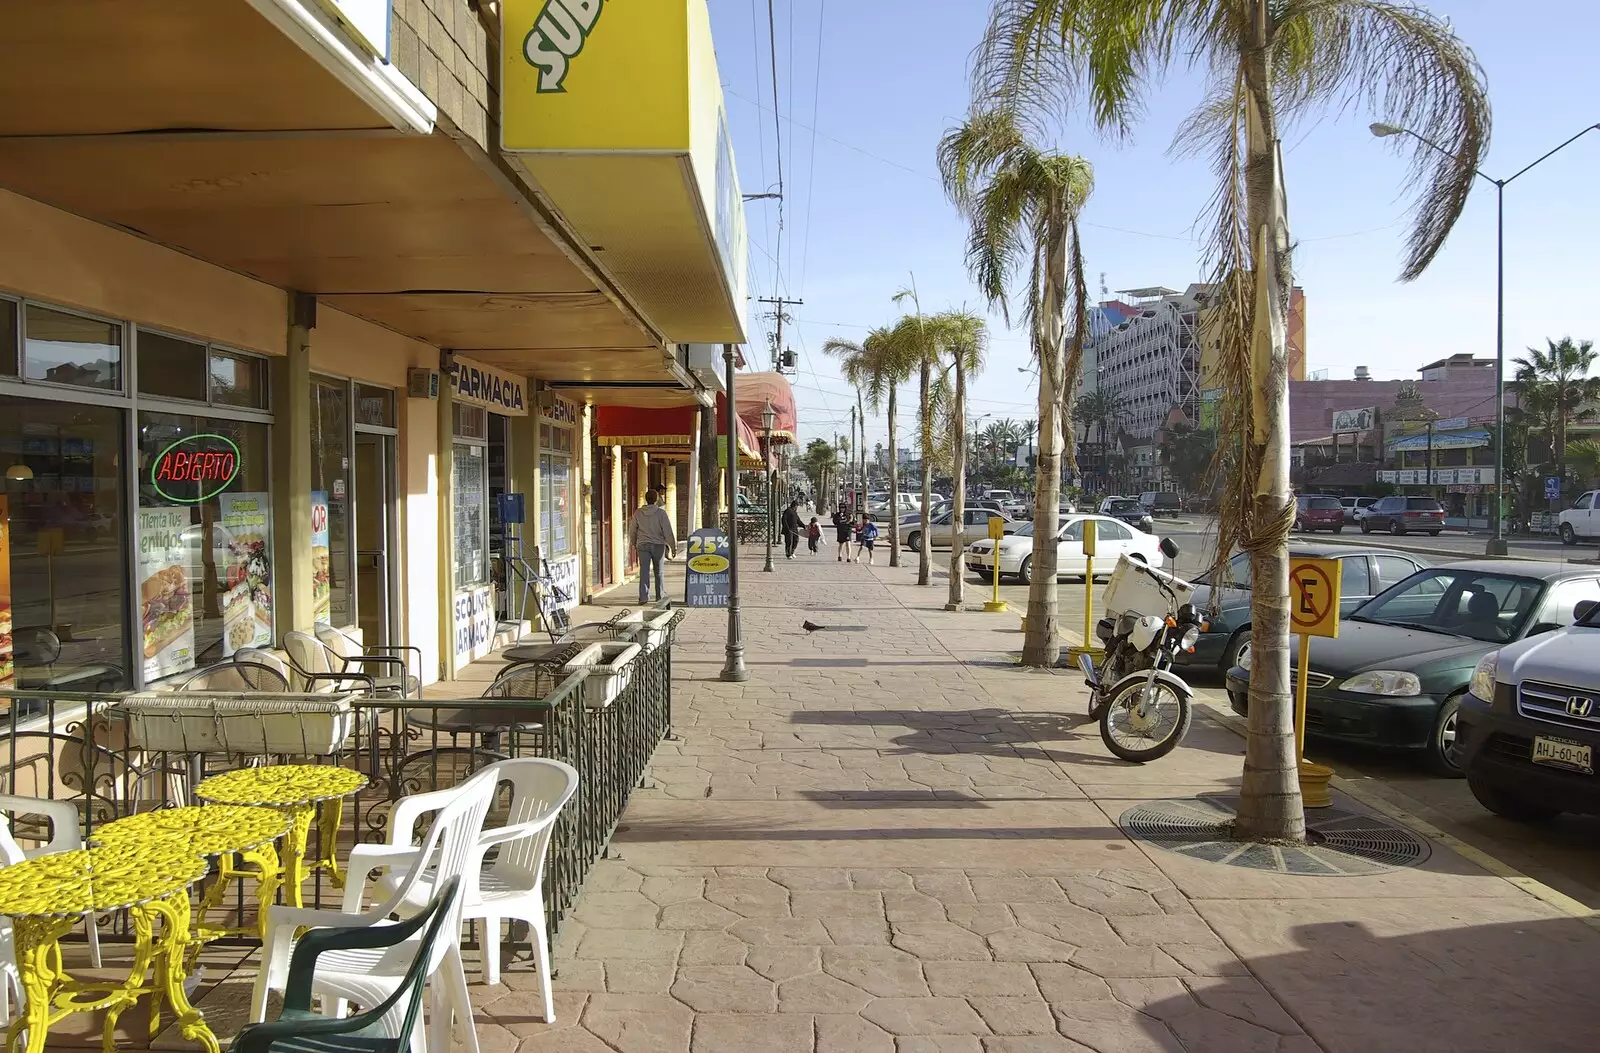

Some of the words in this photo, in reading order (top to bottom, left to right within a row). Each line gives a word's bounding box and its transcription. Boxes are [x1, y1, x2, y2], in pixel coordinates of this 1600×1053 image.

[157, 452, 235, 481] ABIERTO
[311, 505, 327, 534] OR
[689, 536, 729, 554] 25%
[689, 573, 698, 584] EN
[705, 584, 714, 594] DE
[693, 594, 728, 605] PATENTE
[1536, 742, 1590, 765] AHJ-60-04
